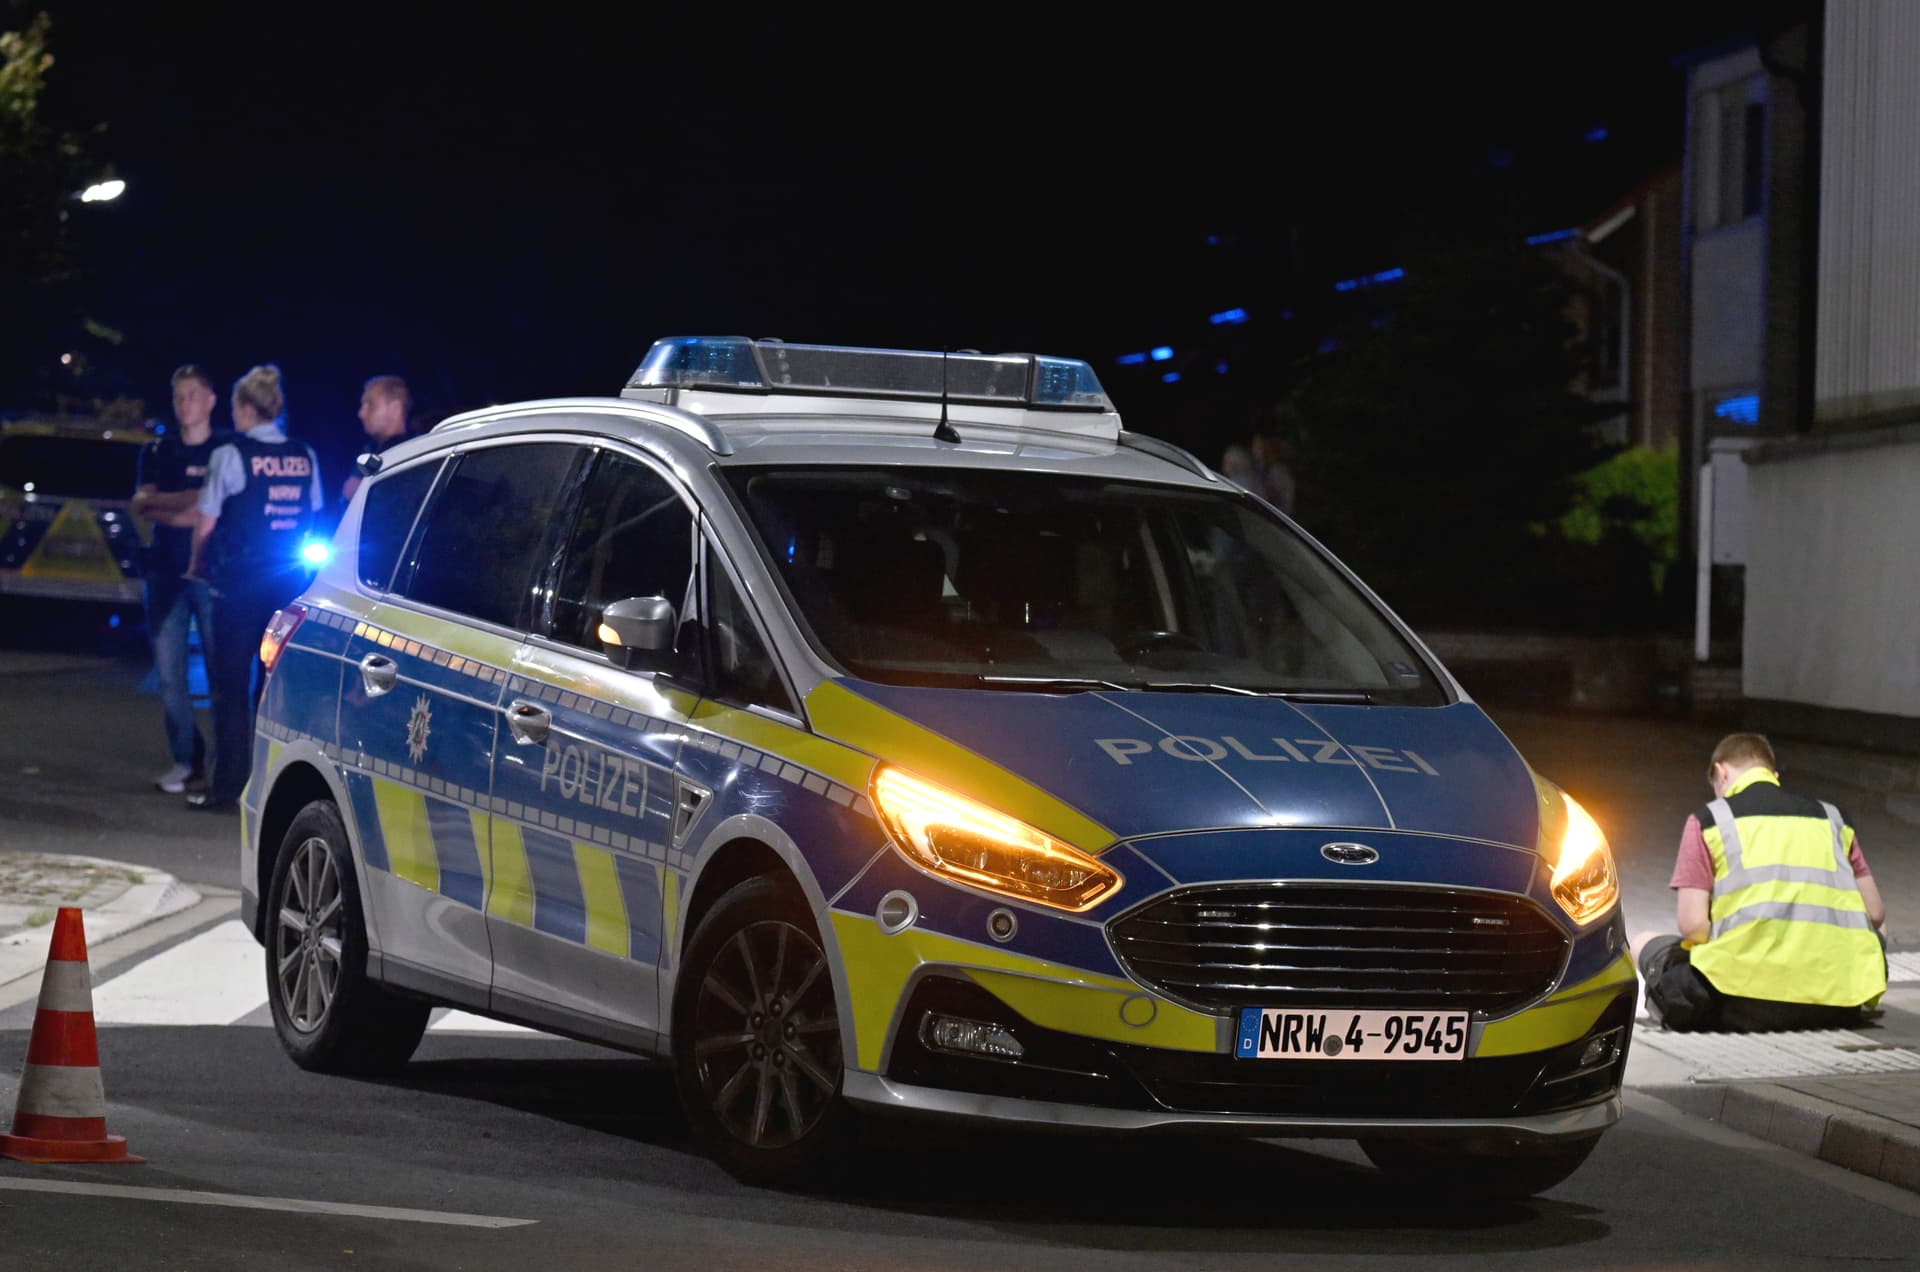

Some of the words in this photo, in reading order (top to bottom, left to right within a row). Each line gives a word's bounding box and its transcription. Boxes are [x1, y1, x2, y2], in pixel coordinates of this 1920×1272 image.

[251, 455, 311, 477] POLIZEI
[1094, 735, 1441, 777] POLIZEI
[541, 739, 648, 819] POLIZEI
[1243, 1038, 1253, 1050] D
[1259, 1013, 1327, 1053] NRW
[1344, 1014, 1466, 1055] 4-9545
